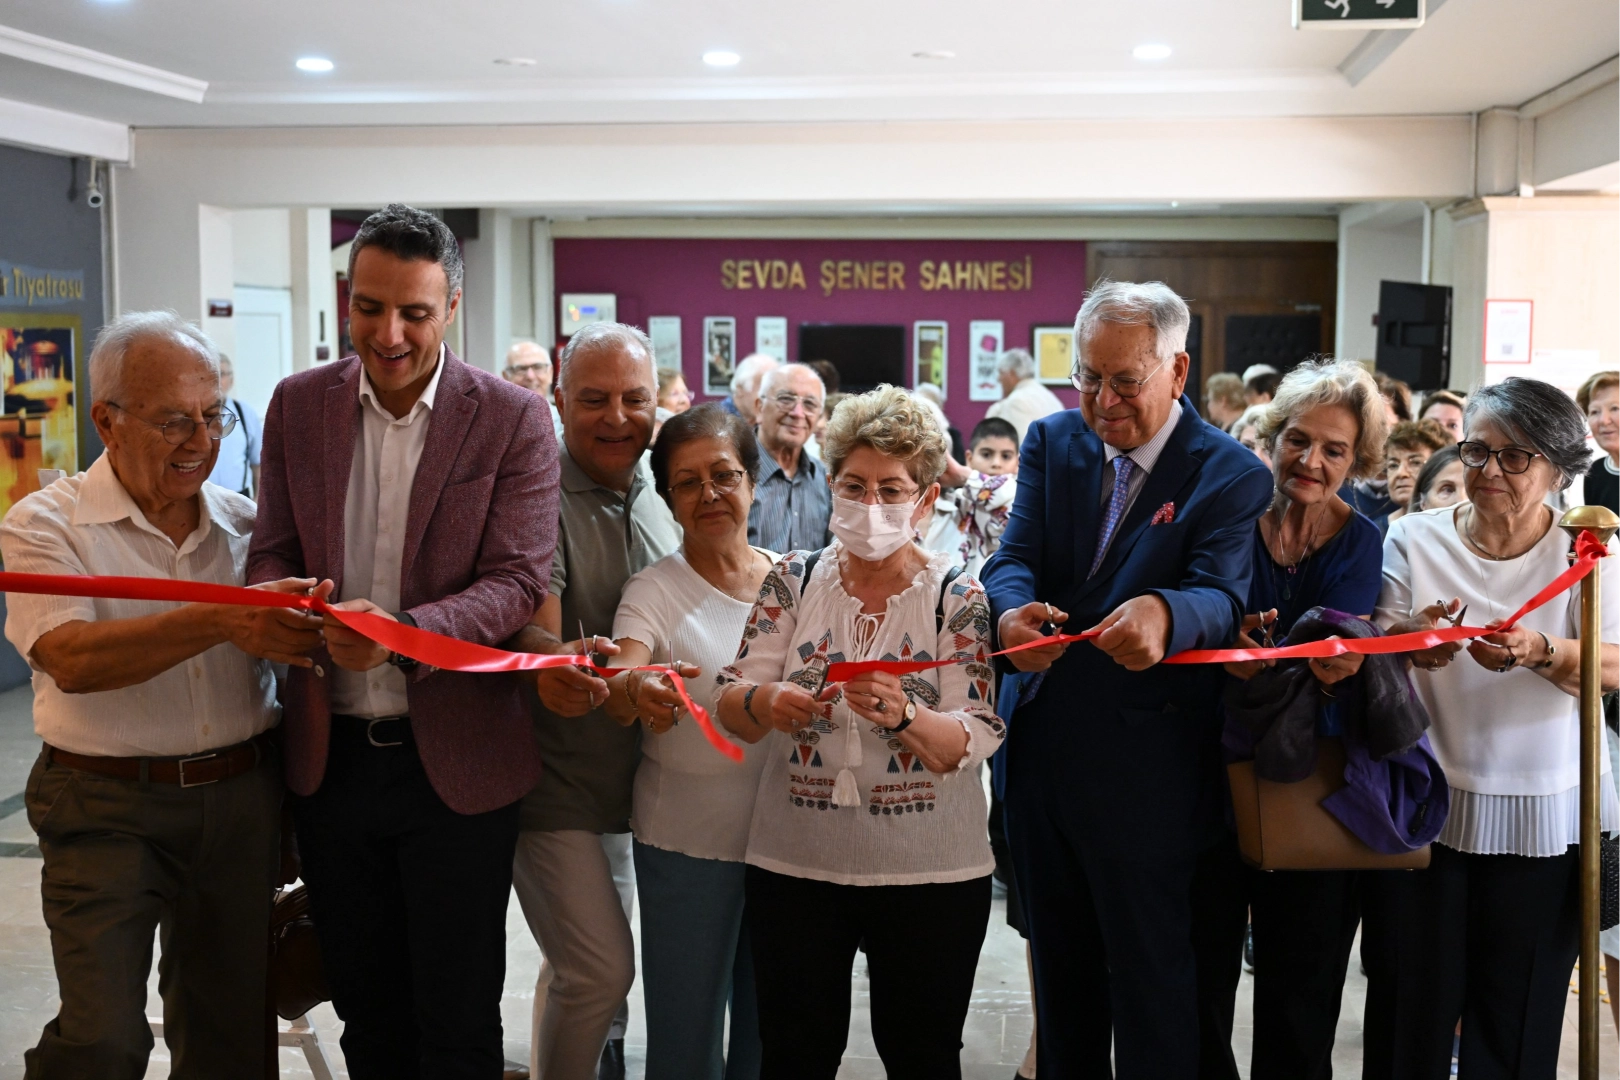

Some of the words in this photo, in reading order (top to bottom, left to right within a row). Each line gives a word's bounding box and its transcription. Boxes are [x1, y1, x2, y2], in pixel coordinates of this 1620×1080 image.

[12, 267, 83, 306] Tiyatrosu
[721, 259, 807, 290] SEVDA
[820, 260, 906, 297] ŞENER
[919, 255, 1032, 291] SAHNESİ
